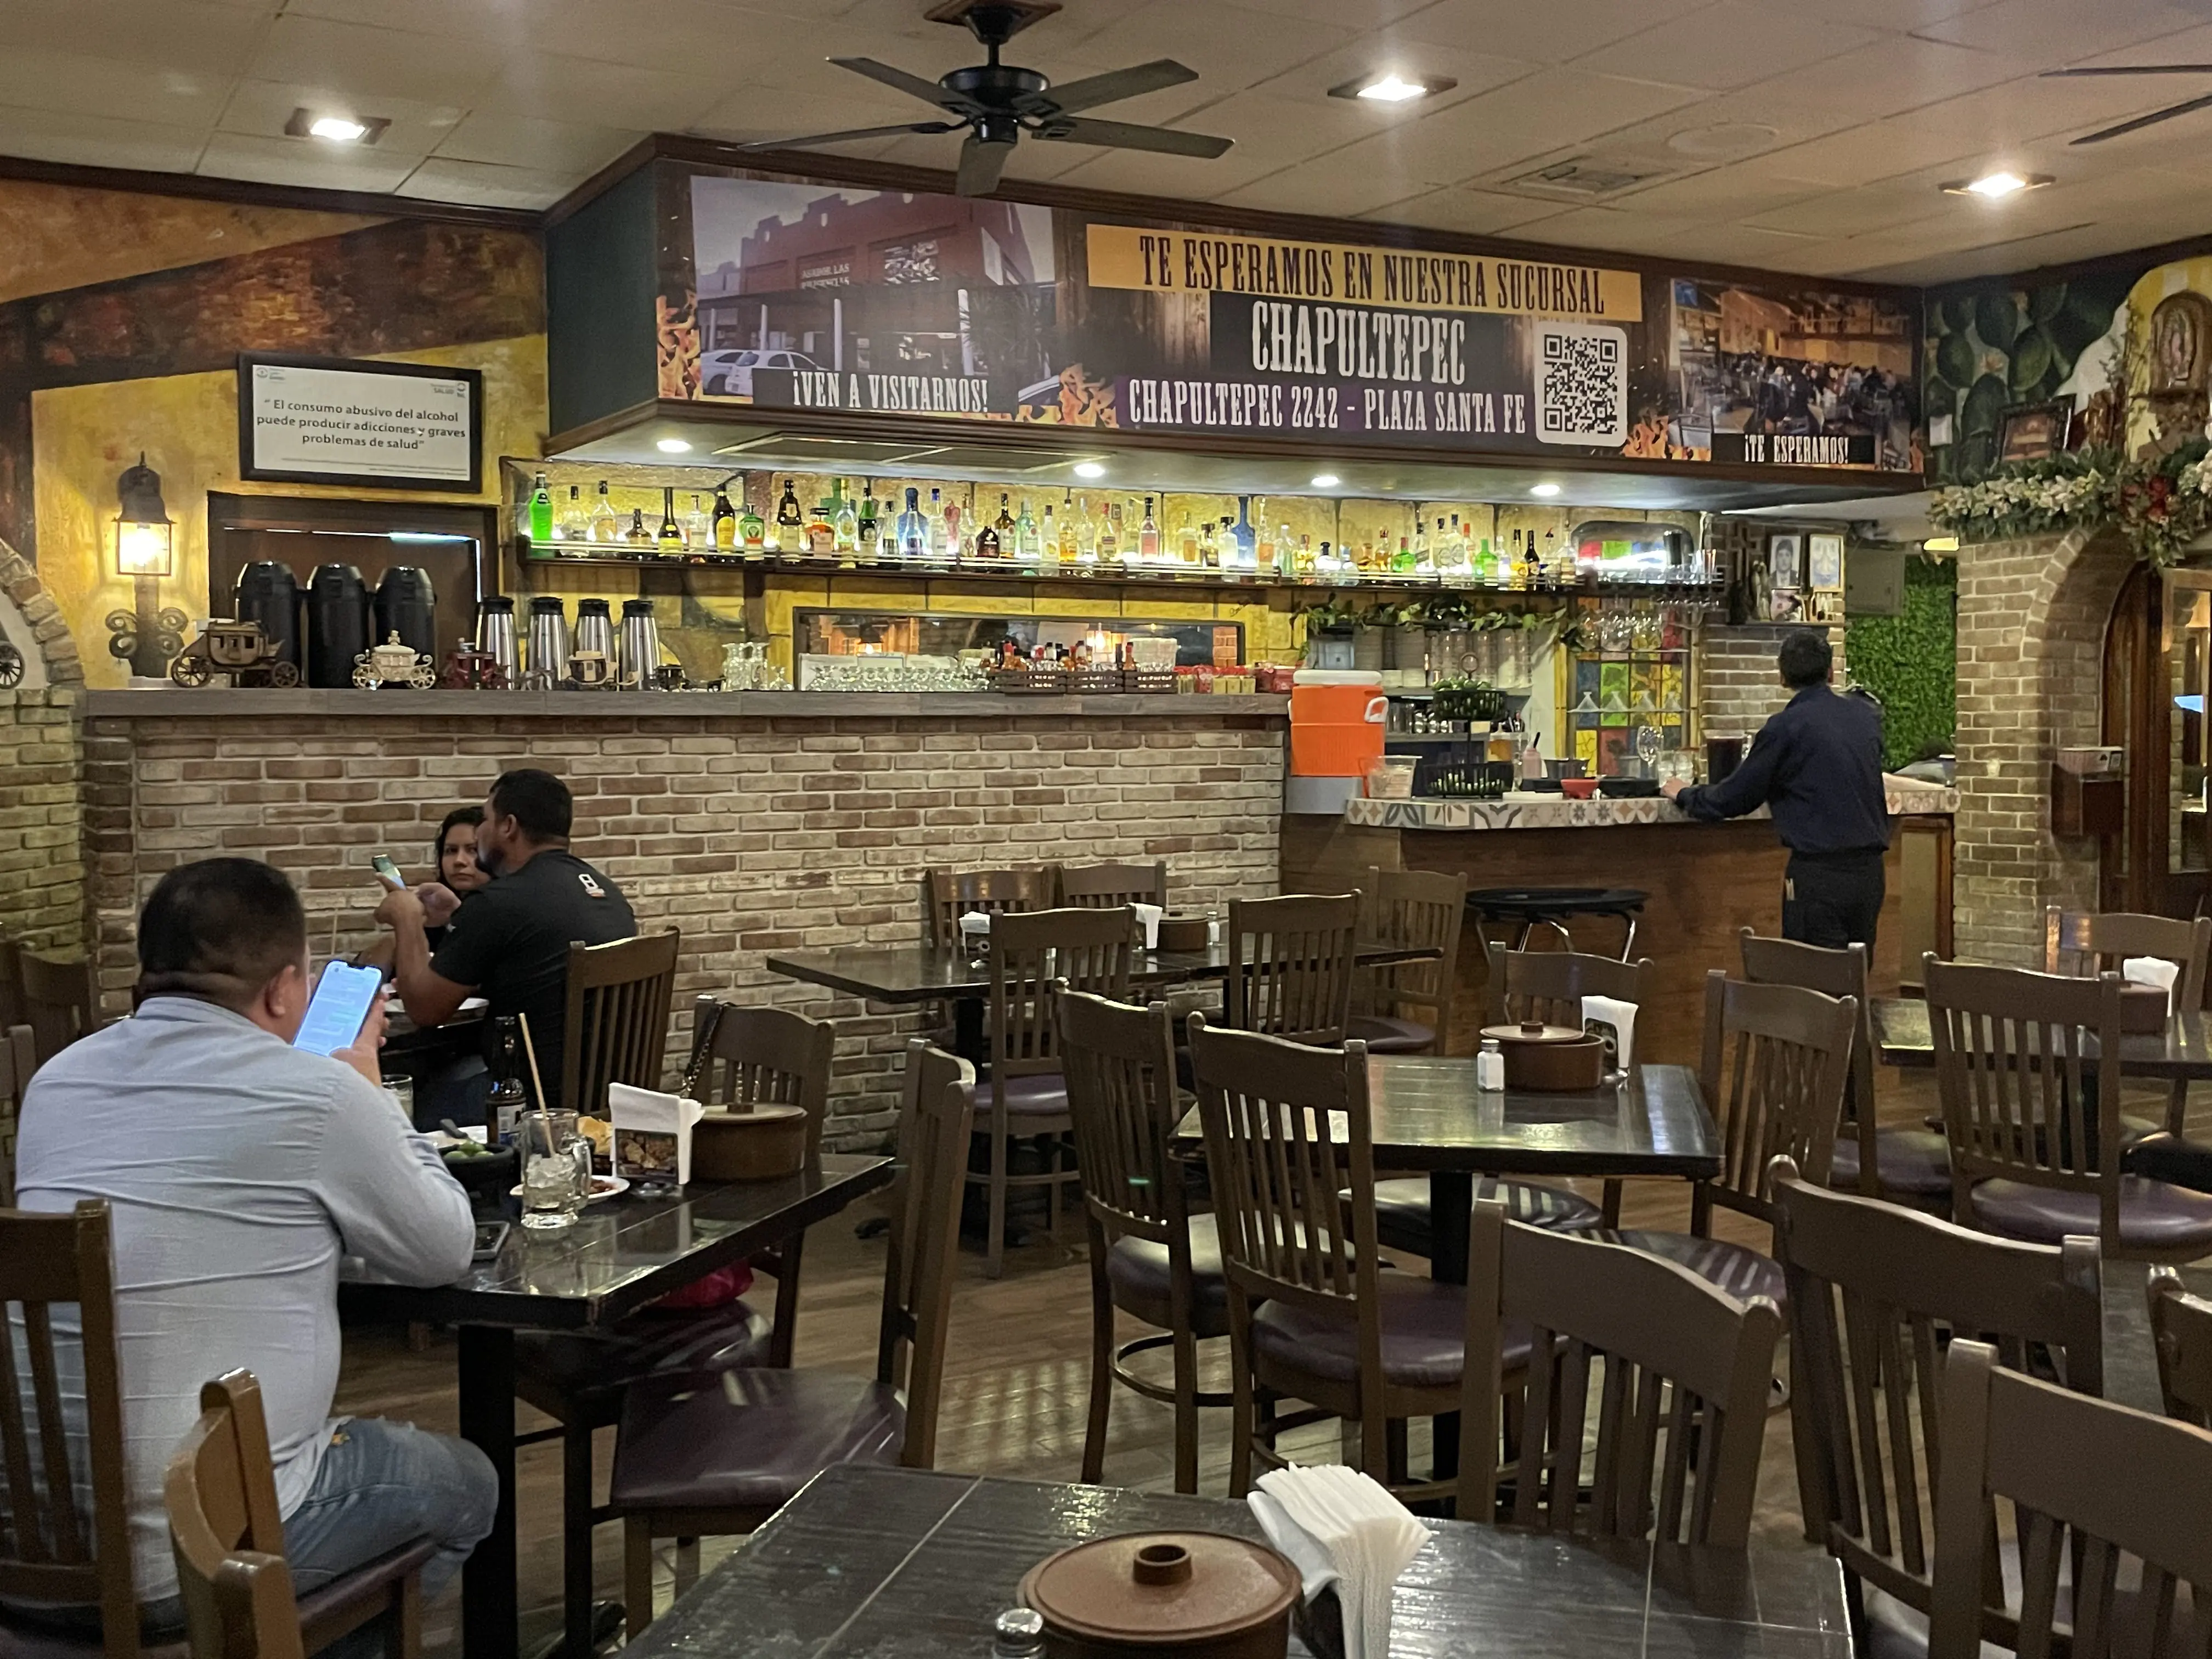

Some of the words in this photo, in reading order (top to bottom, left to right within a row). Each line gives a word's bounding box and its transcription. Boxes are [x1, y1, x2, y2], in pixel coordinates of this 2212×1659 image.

[1140, 235, 1172, 286] TE
[1183, 239, 1333, 297] ESPERAMOS
[1344, 251, 1373, 300] EN
[1383, 254, 1487, 307] NUESTRA
[1497, 263, 1605, 314] SUCURSAL
[1252, 301, 1465, 385] CHAPULTEPEC
[793, 371, 840, 407] ¡VEN
[849, 373, 861, 408] A
[867, 374, 988, 413] VISITARNOS!
[1129, 379, 1283, 427] CHAPULTEPEC
[1291, 386, 1339, 428] 2242
[1364, 388, 1427, 431] PLAZA
[1435, 391, 1496, 433] SANTA
[1503, 394, 1526, 433] FE
[257, 415, 296, 426] puede
[299, 418, 351, 430] producir
[353, 421, 415, 434] adicciones
[428, 428, 466, 438] graves
[287, 403, 342, 414] consumo
[346, 405, 392, 417] abusivo
[395, 408, 413, 419] del
[415, 410, 458, 422] alcohol
[302, 434, 366, 446] problemas
[369, 437, 383, 447] de
[1745, 435, 1765, 462] ¡TE
[1773, 435, 1849, 465] ESPERAMOS!
